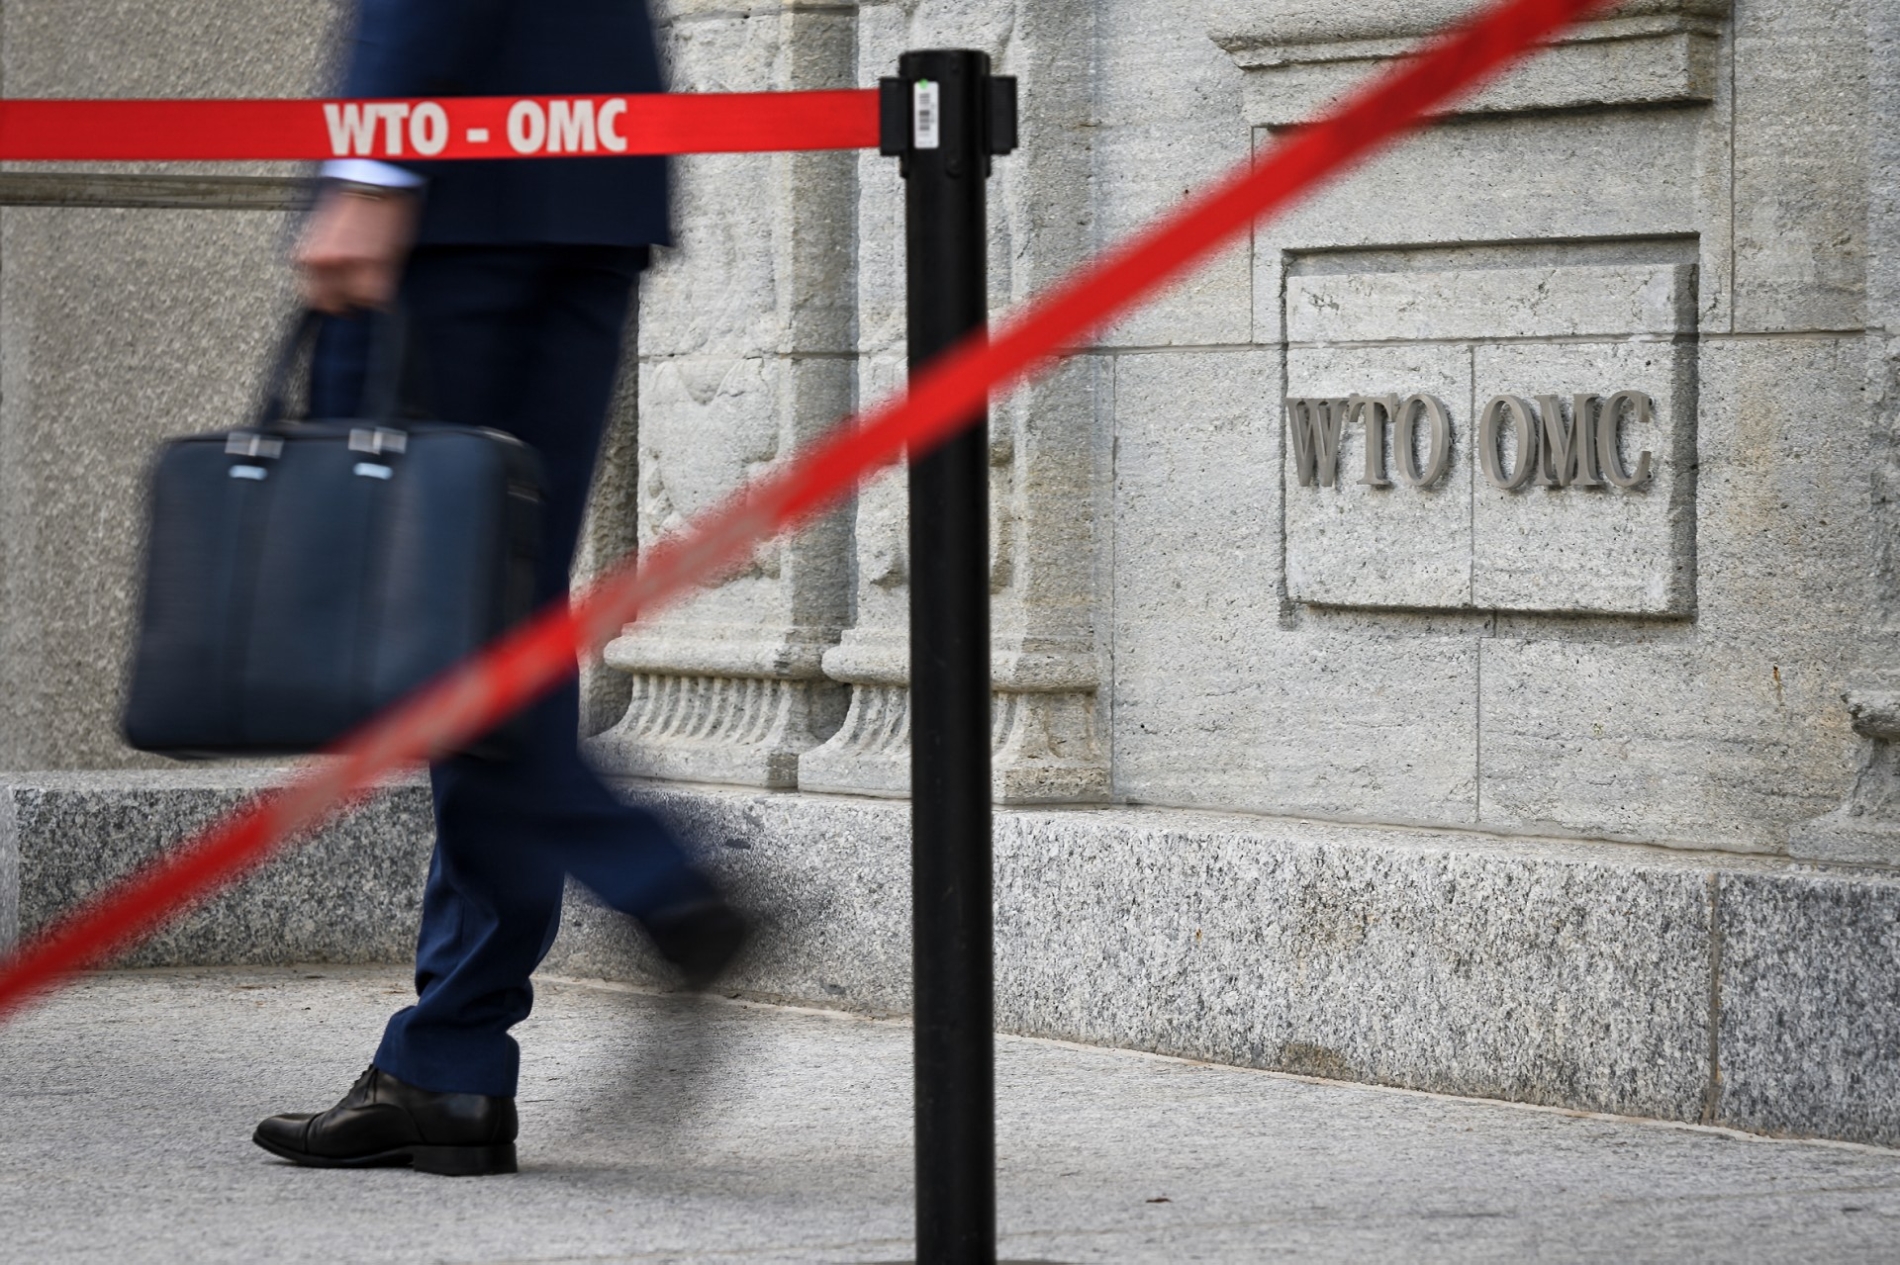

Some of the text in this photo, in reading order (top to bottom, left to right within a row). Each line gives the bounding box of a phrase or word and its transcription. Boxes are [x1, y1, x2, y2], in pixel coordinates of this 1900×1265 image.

[323, 98, 628, 156] WTO - OMC
[1286, 390, 1653, 490] WTO OMC
